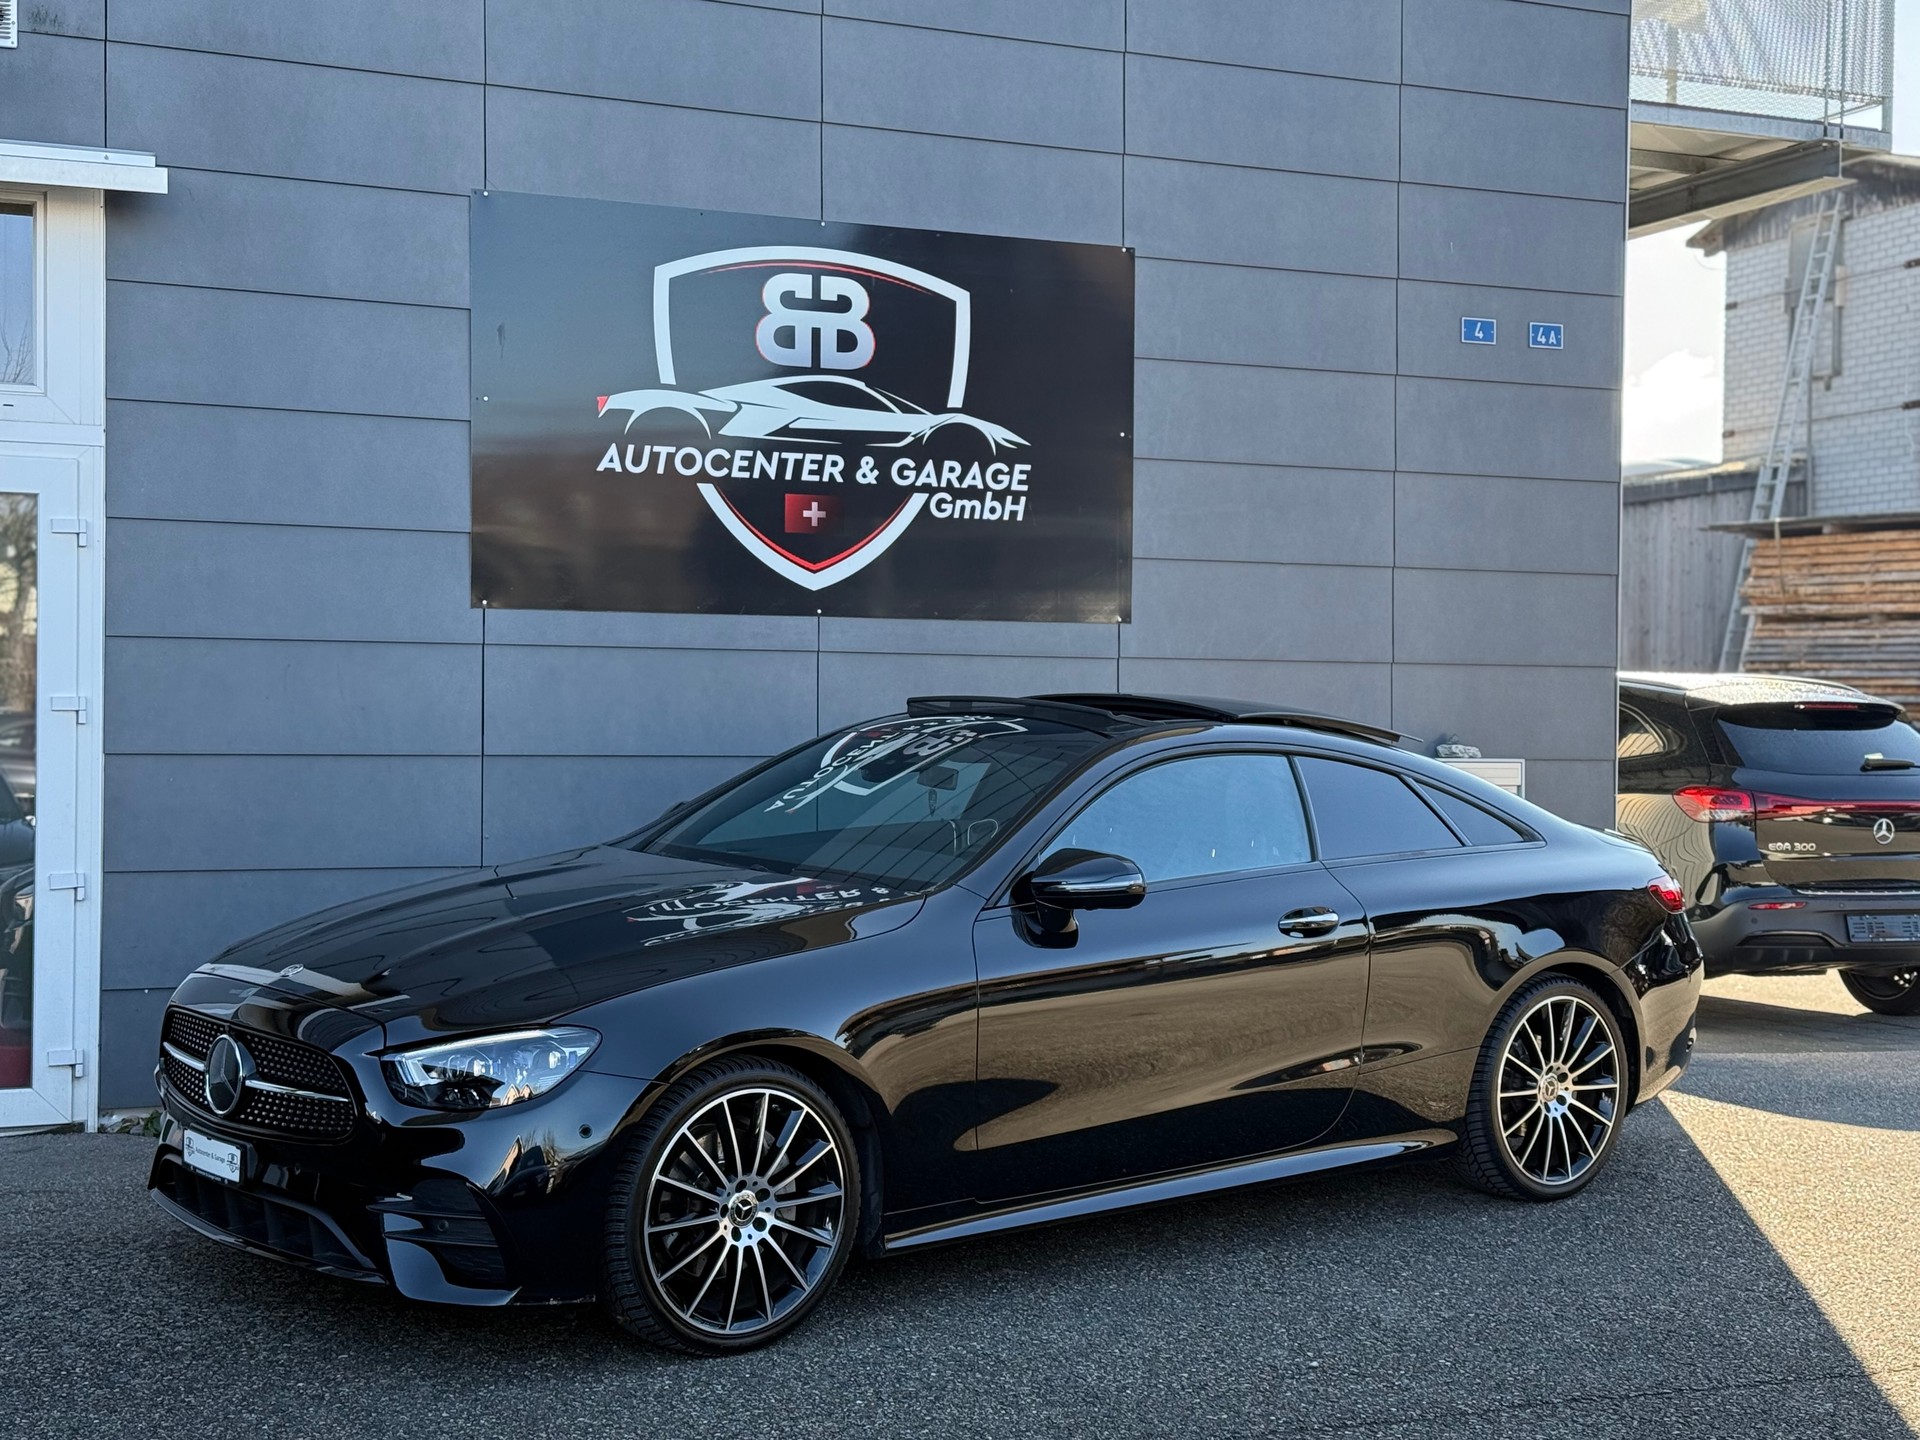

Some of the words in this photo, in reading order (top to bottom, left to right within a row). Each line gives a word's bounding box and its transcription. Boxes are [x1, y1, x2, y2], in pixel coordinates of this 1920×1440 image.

[1474, 322, 1484, 339] 4
[1536, 327, 1557, 345] 4A
[596, 442, 844, 483] AUTOCENTER
[855, 455, 879, 485] &
[890, 457, 1032, 492] GARAGE
[929, 491, 1027, 522] GmbH
[1794, 842, 1817, 851] 300
